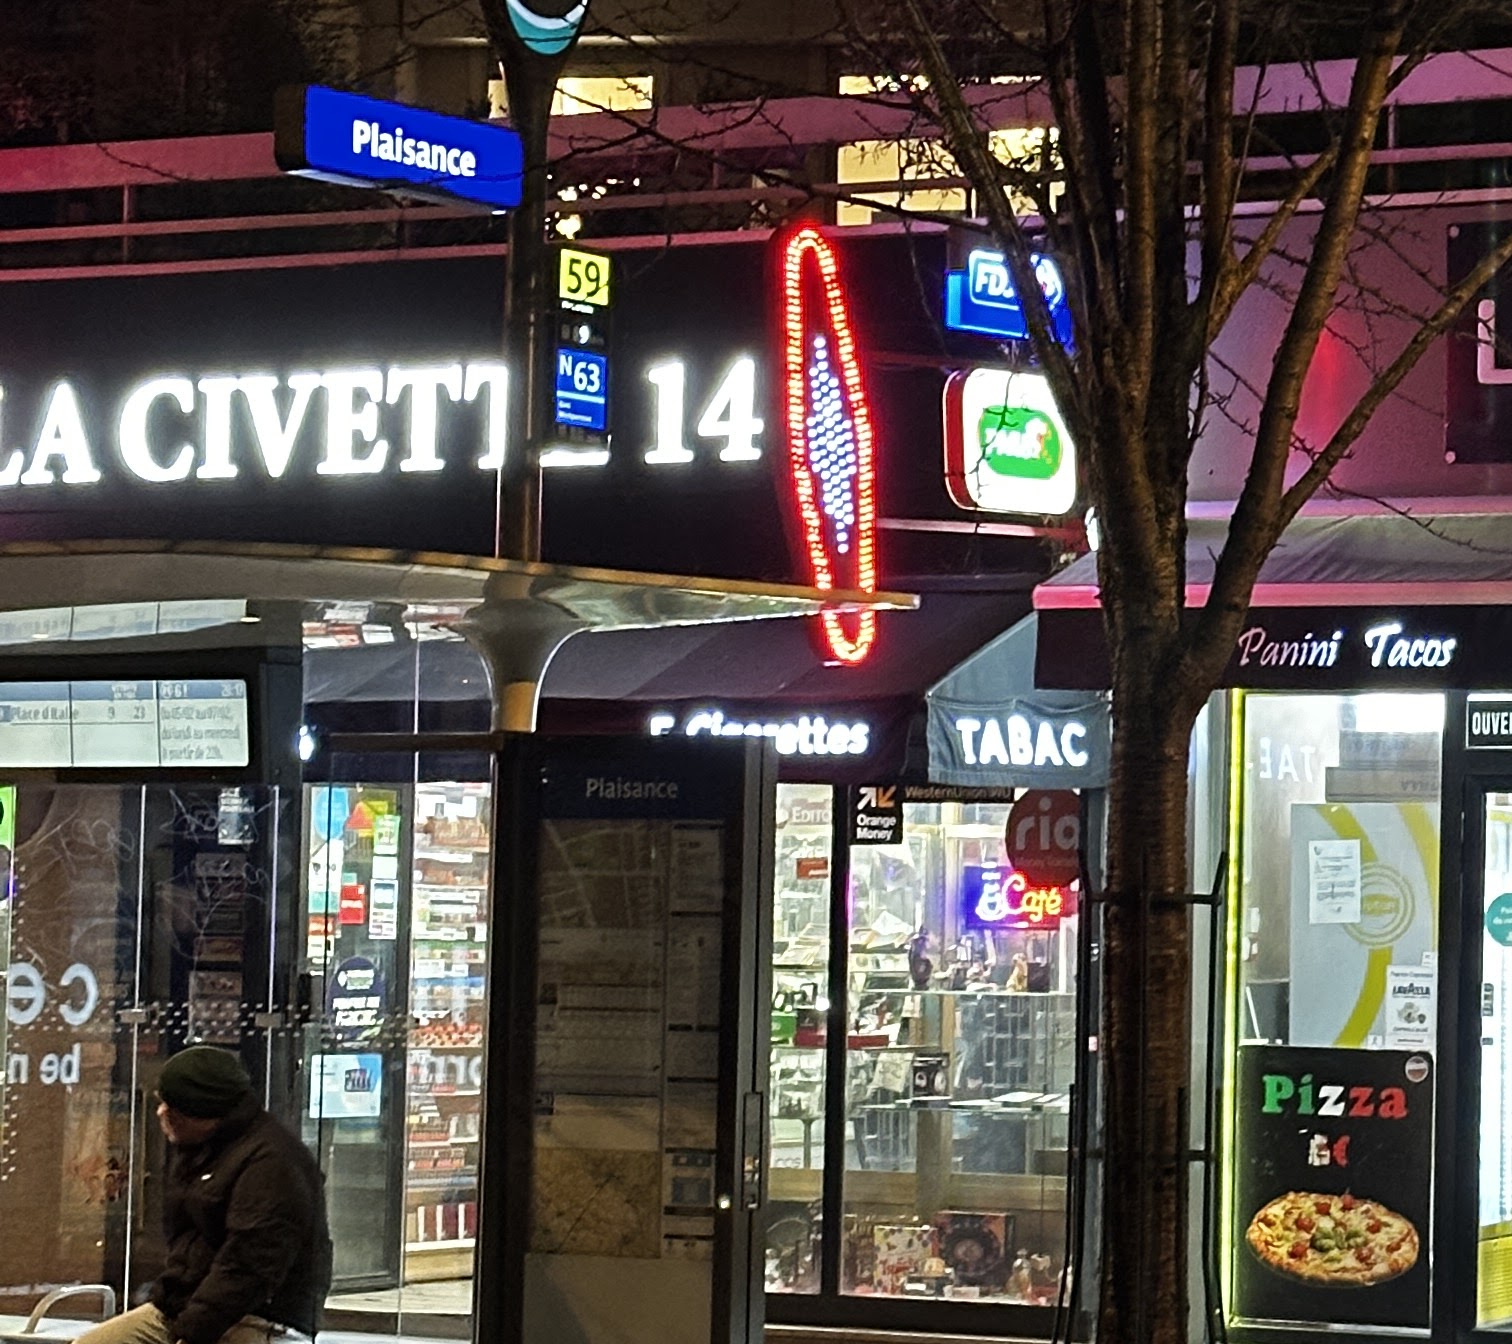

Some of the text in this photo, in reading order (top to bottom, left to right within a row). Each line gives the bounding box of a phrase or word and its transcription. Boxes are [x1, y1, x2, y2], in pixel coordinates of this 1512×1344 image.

[352, 119, 477, 178] Plaisance
[567, 258, 601, 297] 59
[644, 357, 764, 465] 14
[1238, 628, 1343, 668] Panini
[1364, 622, 1457, 669] Tacos
[956, 719, 1088, 768] TABAC
[586, 777, 679, 800] Plaisance
[857, 814, 897, 829] Orange
[857, 828, 894, 841] Money
[999, 873, 1062, 923] Café
[1261, 1073, 1408, 1119] Pizza
